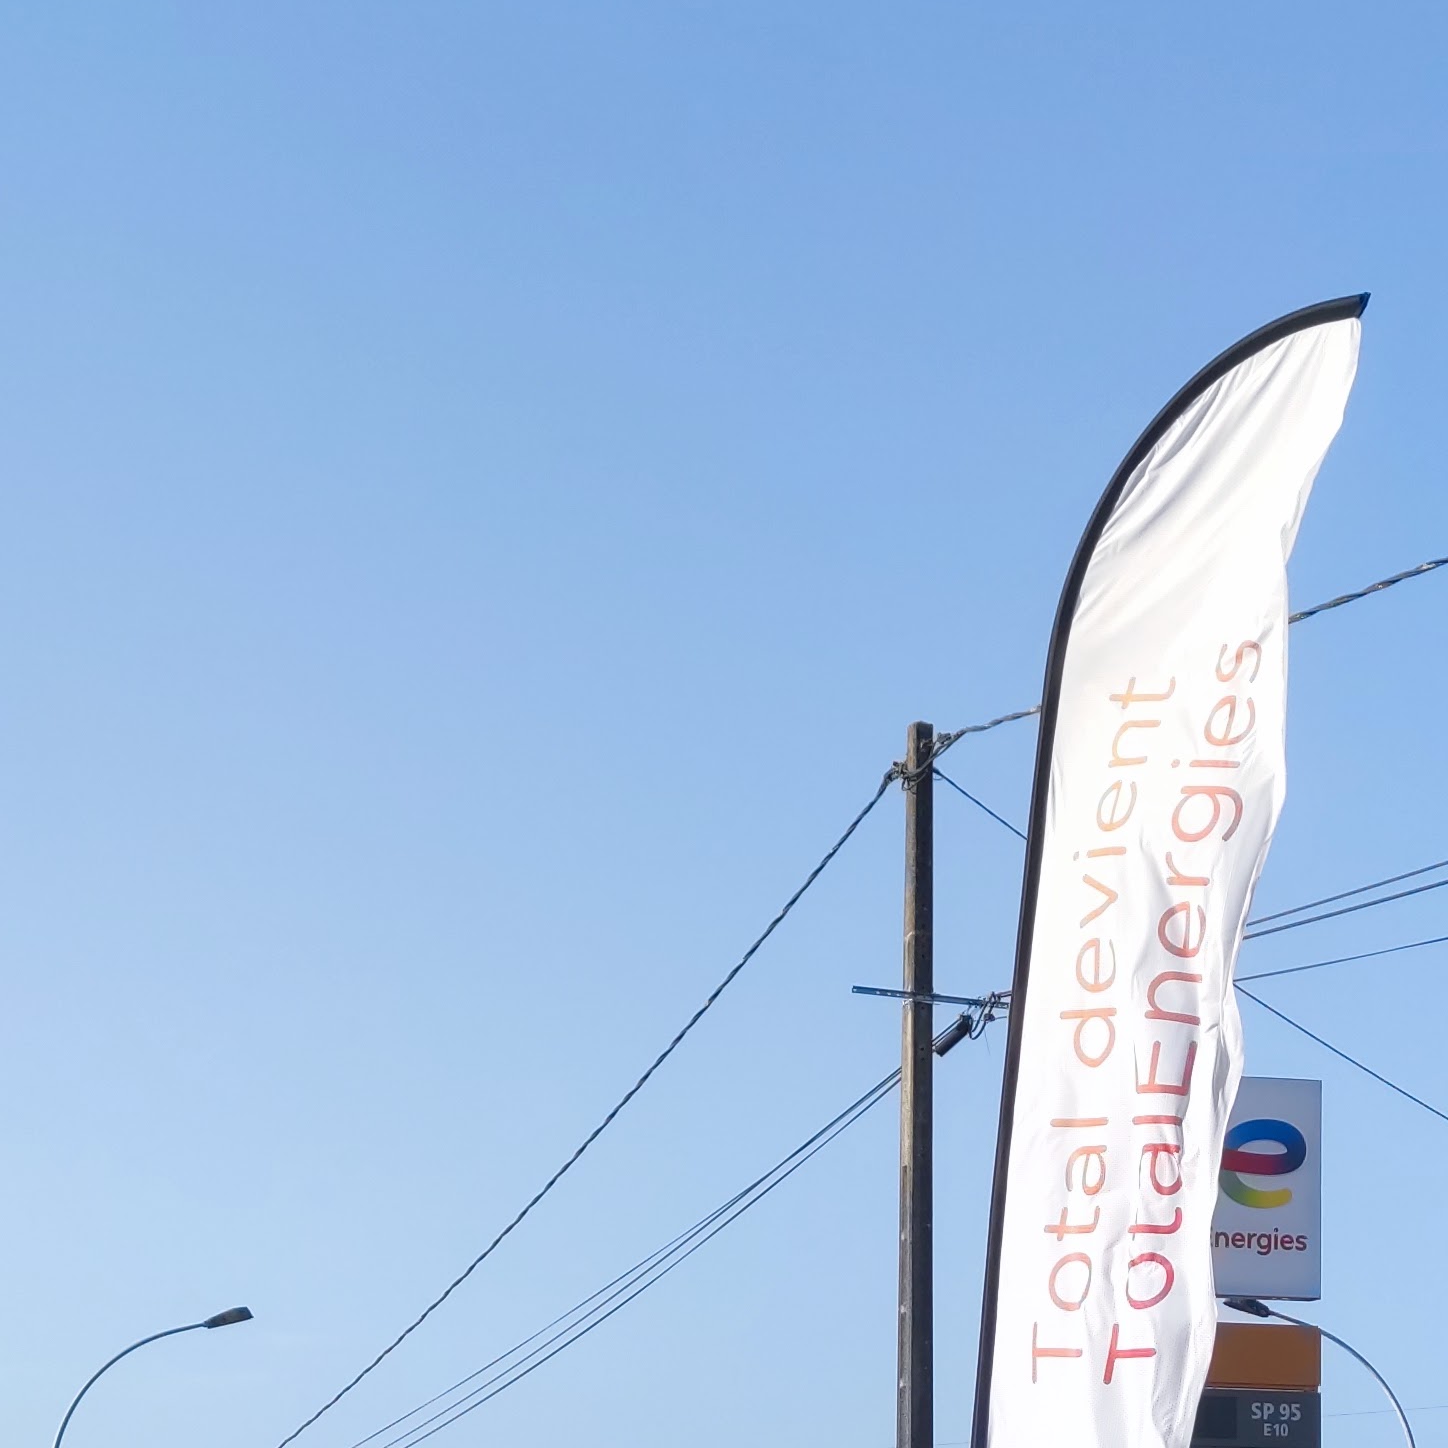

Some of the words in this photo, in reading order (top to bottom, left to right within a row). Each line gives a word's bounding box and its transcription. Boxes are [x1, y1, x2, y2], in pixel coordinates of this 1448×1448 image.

[1059, 676, 1176, 1068] devient
[1102, 639, 1263, 1385] TotalEnergies
[1031, 1116, 1109, 1385] Total
[1210, 1226, 1309, 1256] nergies
[1251, 1402, 1275, 1420] SP
[1279, 1403, 1302, 1421] 95
[1263, 1423, 1289, 1437] E10
